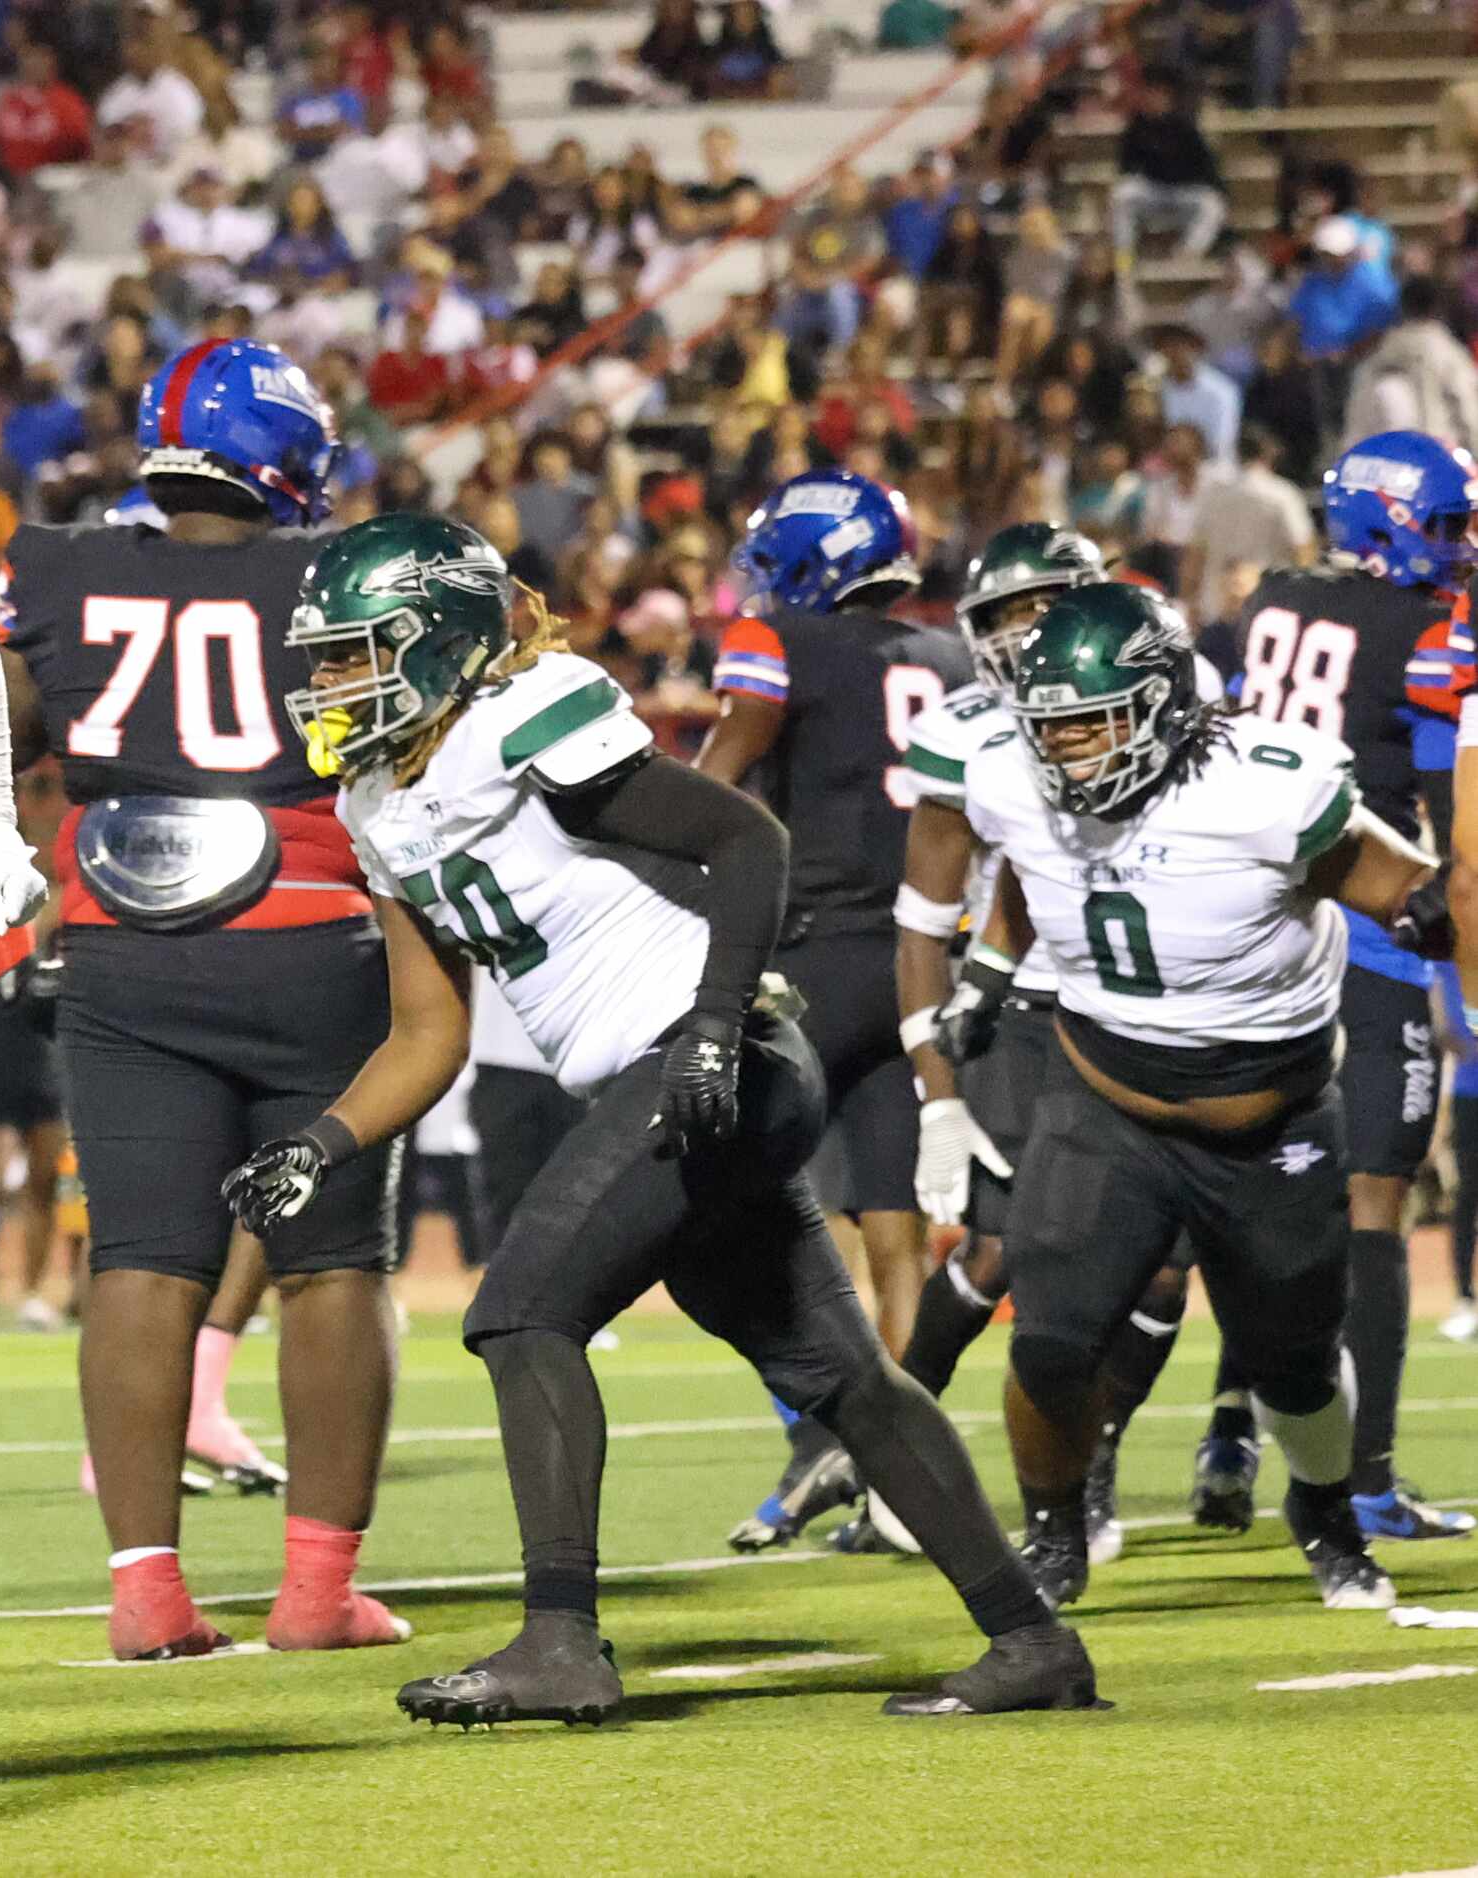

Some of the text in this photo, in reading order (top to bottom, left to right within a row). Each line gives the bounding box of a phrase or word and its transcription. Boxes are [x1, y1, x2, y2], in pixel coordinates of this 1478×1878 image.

[68, 596, 283, 773] 70
[1240, 606, 1358, 738] 88
[1250, 744, 1302, 770] 0
[1082, 891, 1166, 998] 0
